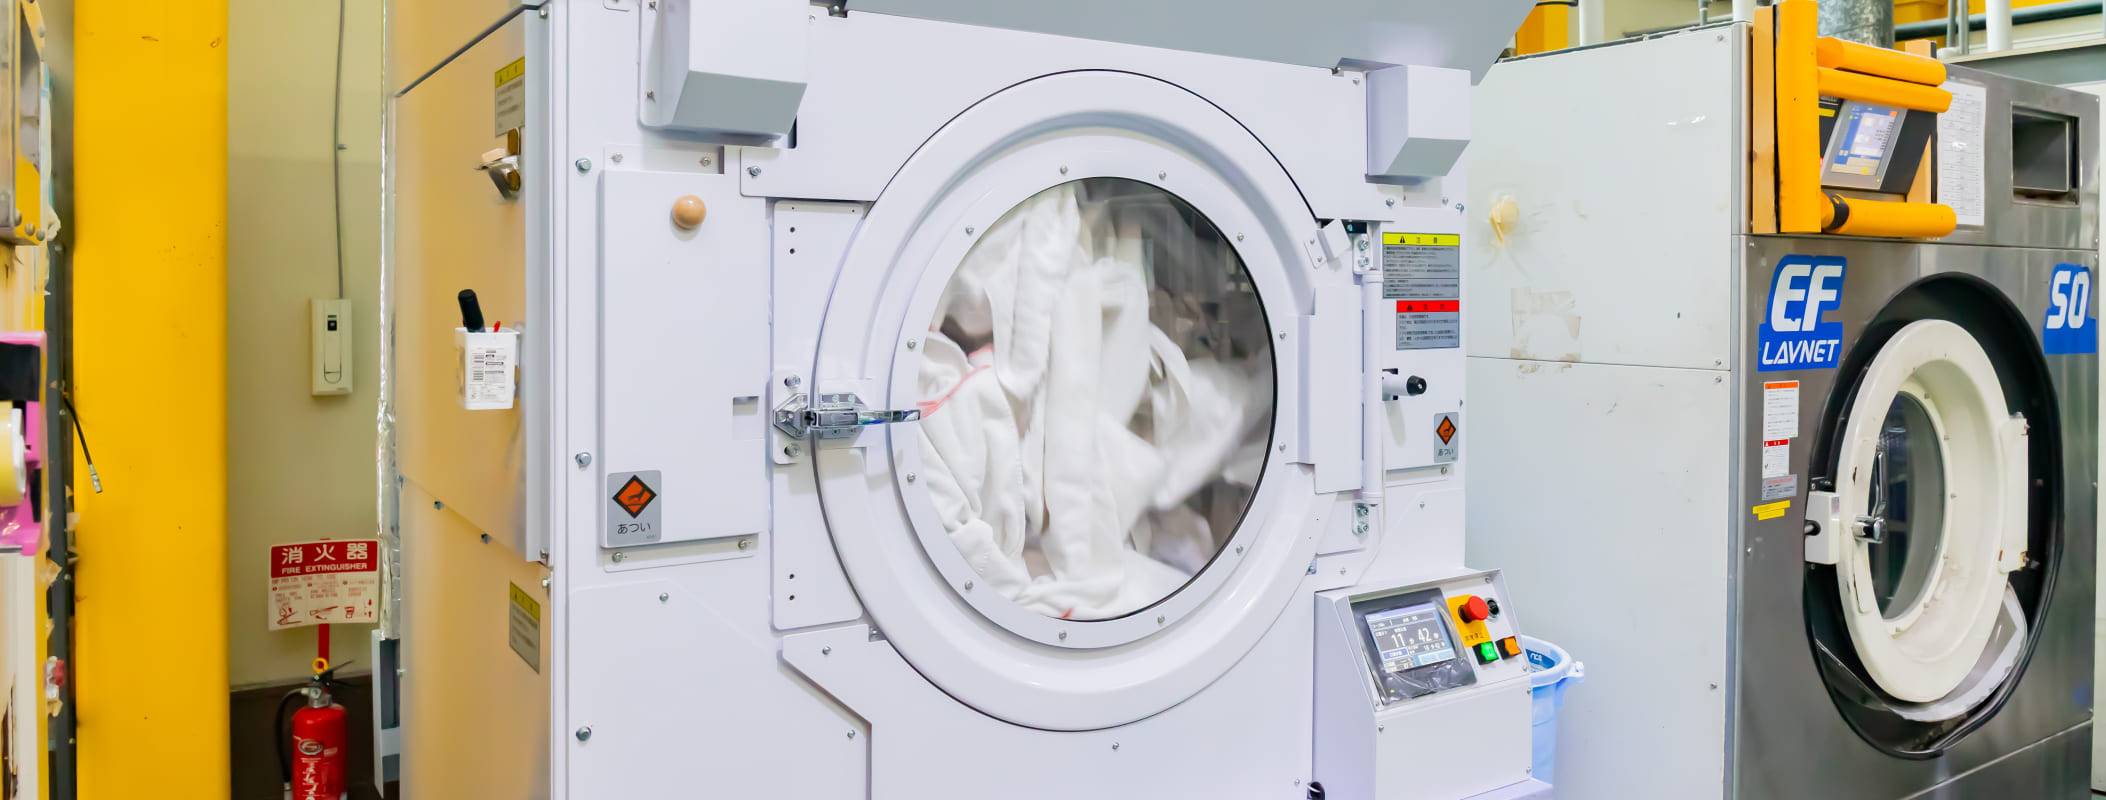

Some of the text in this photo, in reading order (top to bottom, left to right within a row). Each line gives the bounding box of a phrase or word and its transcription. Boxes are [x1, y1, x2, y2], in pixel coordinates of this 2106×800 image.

[1771, 264, 1843, 332] EF
[1762, 339, 1840, 365] LAVNET
[617, 522, 651, 535] あつい
[281, 542, 368, 565] 消火器
[281, 562, 368, 575] FIRE EXTINGUISHER
[1391, 632, 1406, 648] 11
[1417, 627, 1433, 642] 42
